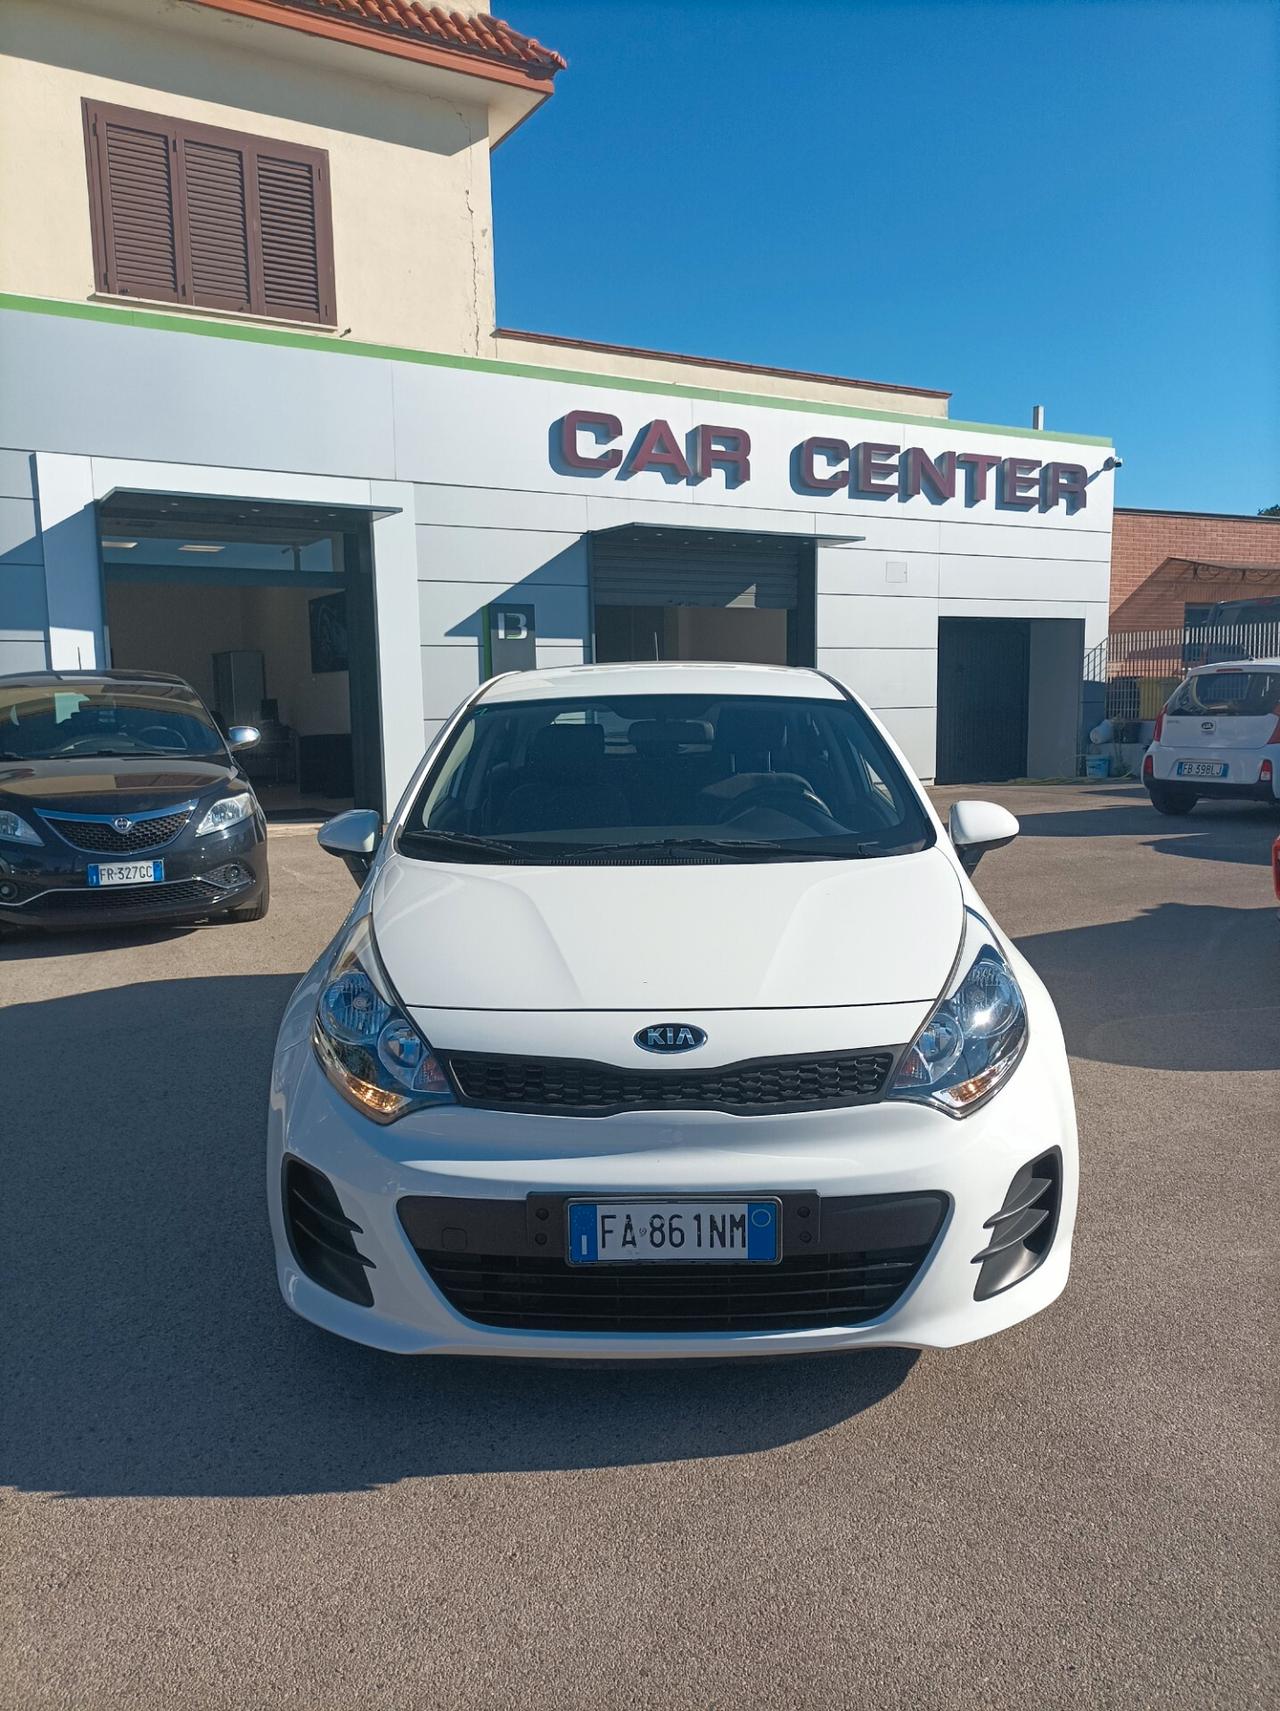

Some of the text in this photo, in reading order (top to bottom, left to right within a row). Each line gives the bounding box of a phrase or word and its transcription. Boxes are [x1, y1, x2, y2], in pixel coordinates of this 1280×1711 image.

[563, 410, 1088, 509] CAR CENTER
[647, 1027, 696, 1046] KIA
